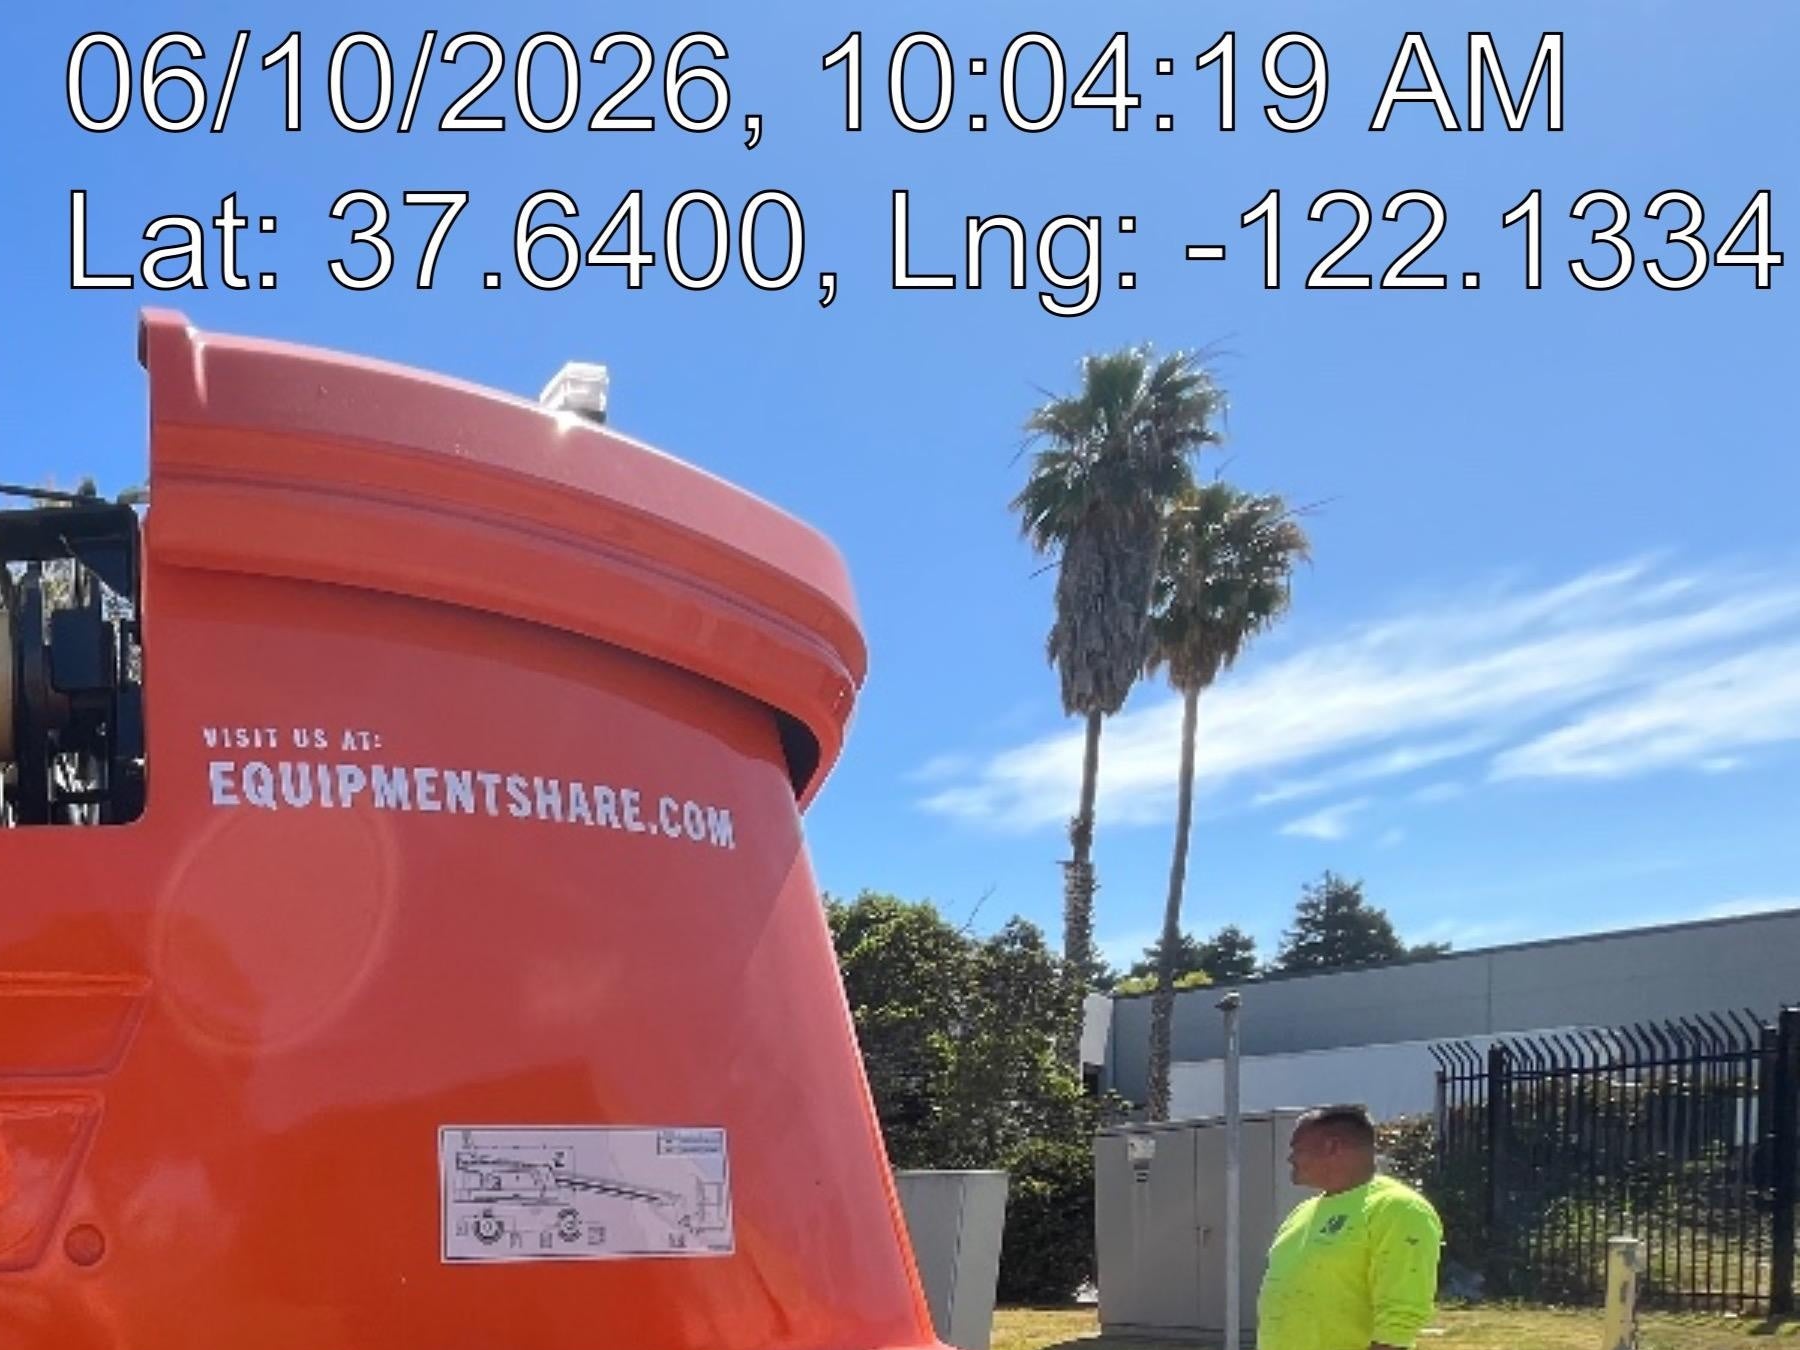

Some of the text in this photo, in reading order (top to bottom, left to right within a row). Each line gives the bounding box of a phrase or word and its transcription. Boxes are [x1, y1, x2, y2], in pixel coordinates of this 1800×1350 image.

[203, 728, 383, 751] VISIT US AT:
[208, 761, 736, 850] EQUIPMENTSHARE.COM
